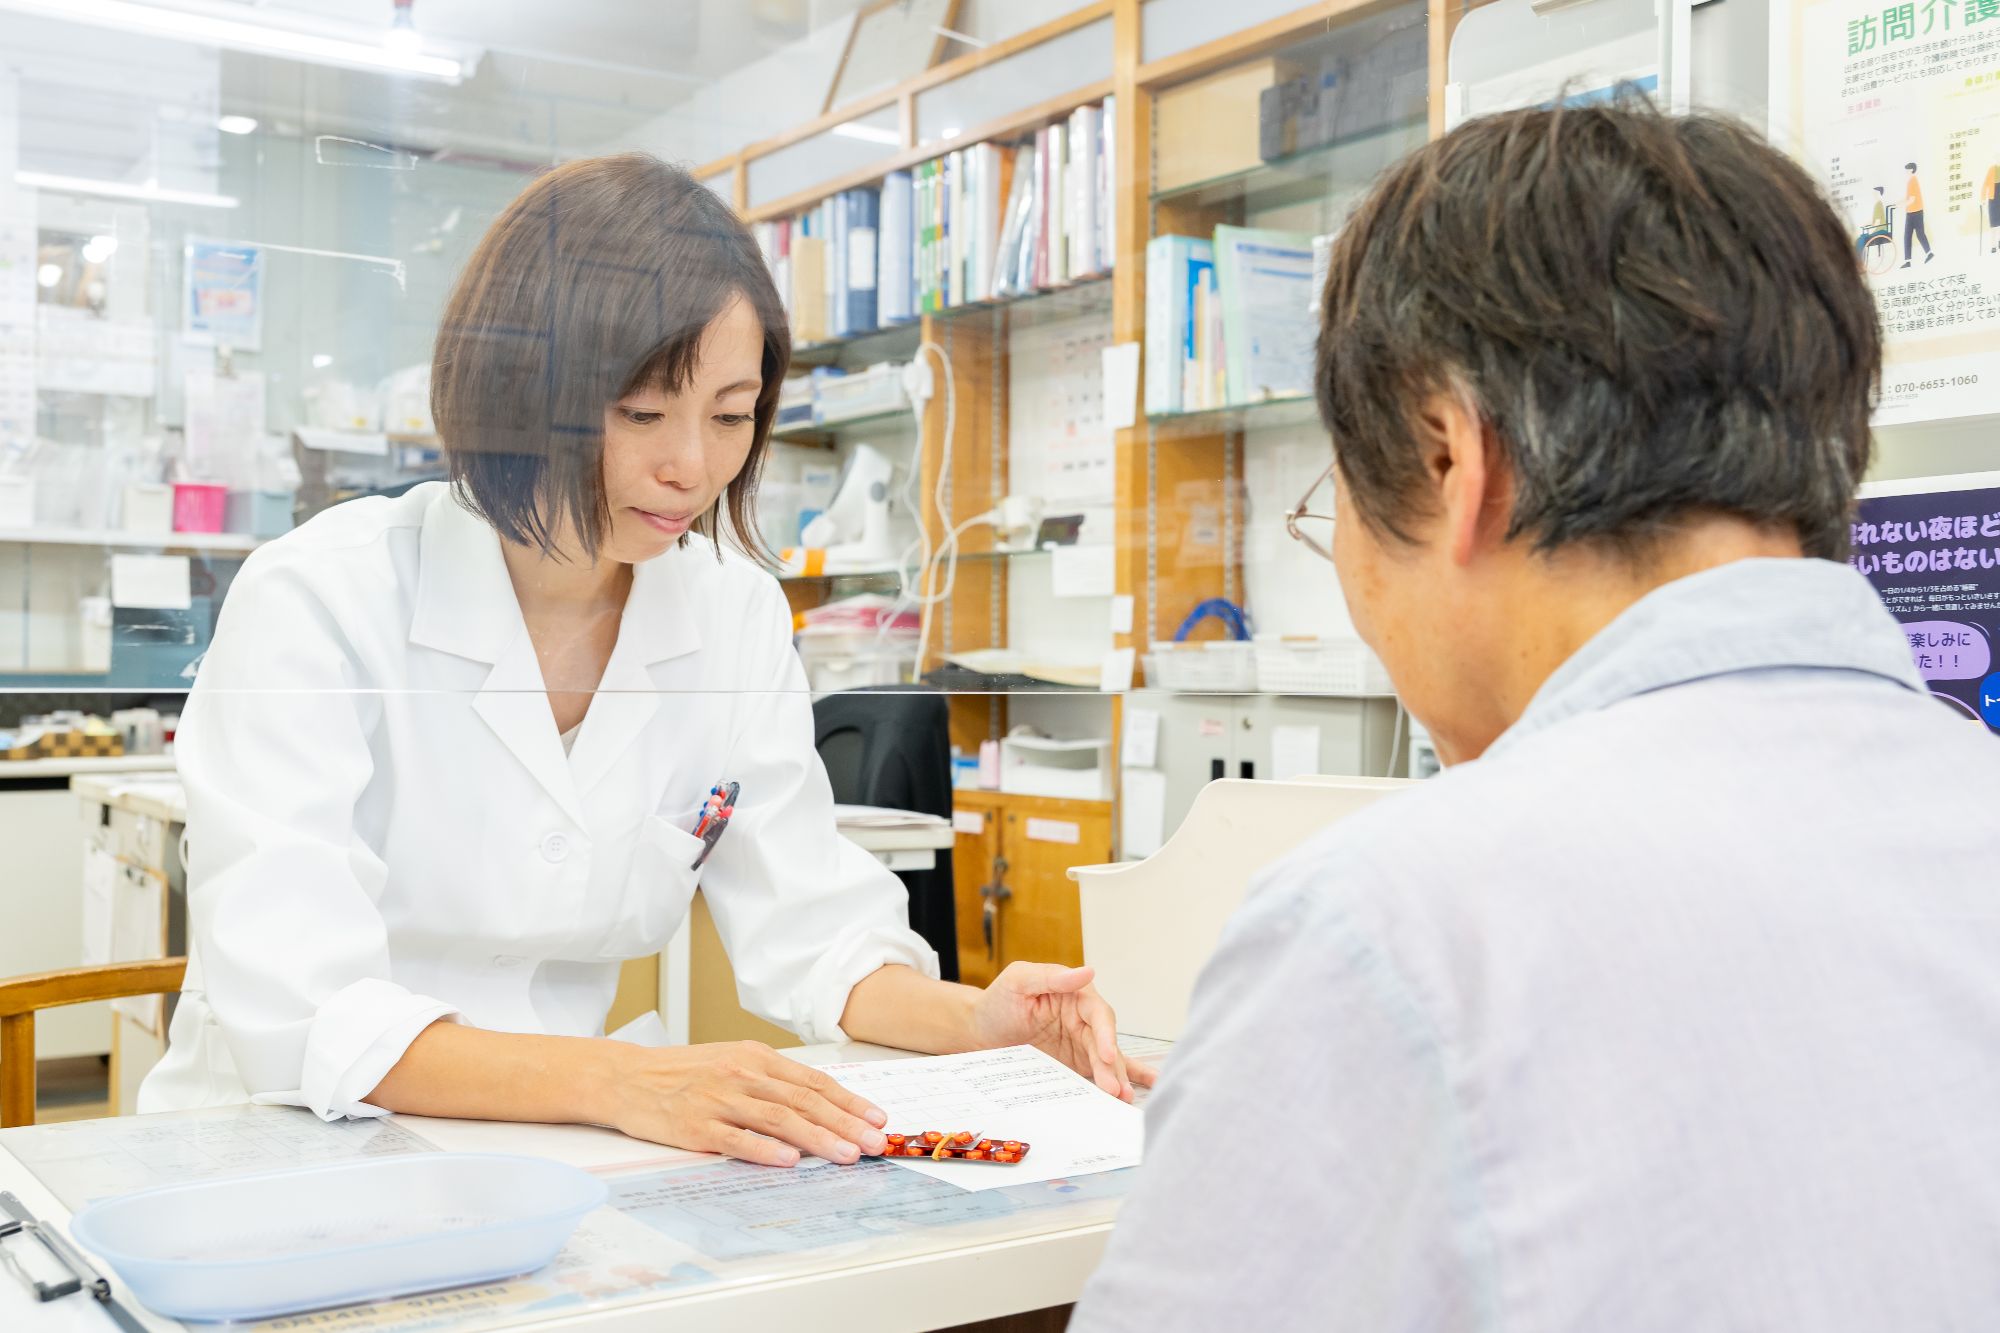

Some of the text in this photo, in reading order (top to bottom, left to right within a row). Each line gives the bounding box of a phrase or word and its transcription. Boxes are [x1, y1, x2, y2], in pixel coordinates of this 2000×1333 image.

[1876, 306, 2000, 333] でも連絡をお待ちしてお
[1849, 547, 2000, 576] いものはない
[1906, 632, 1971, 648] 楽しみに
[1914, 653, 1958, 668] た！！
